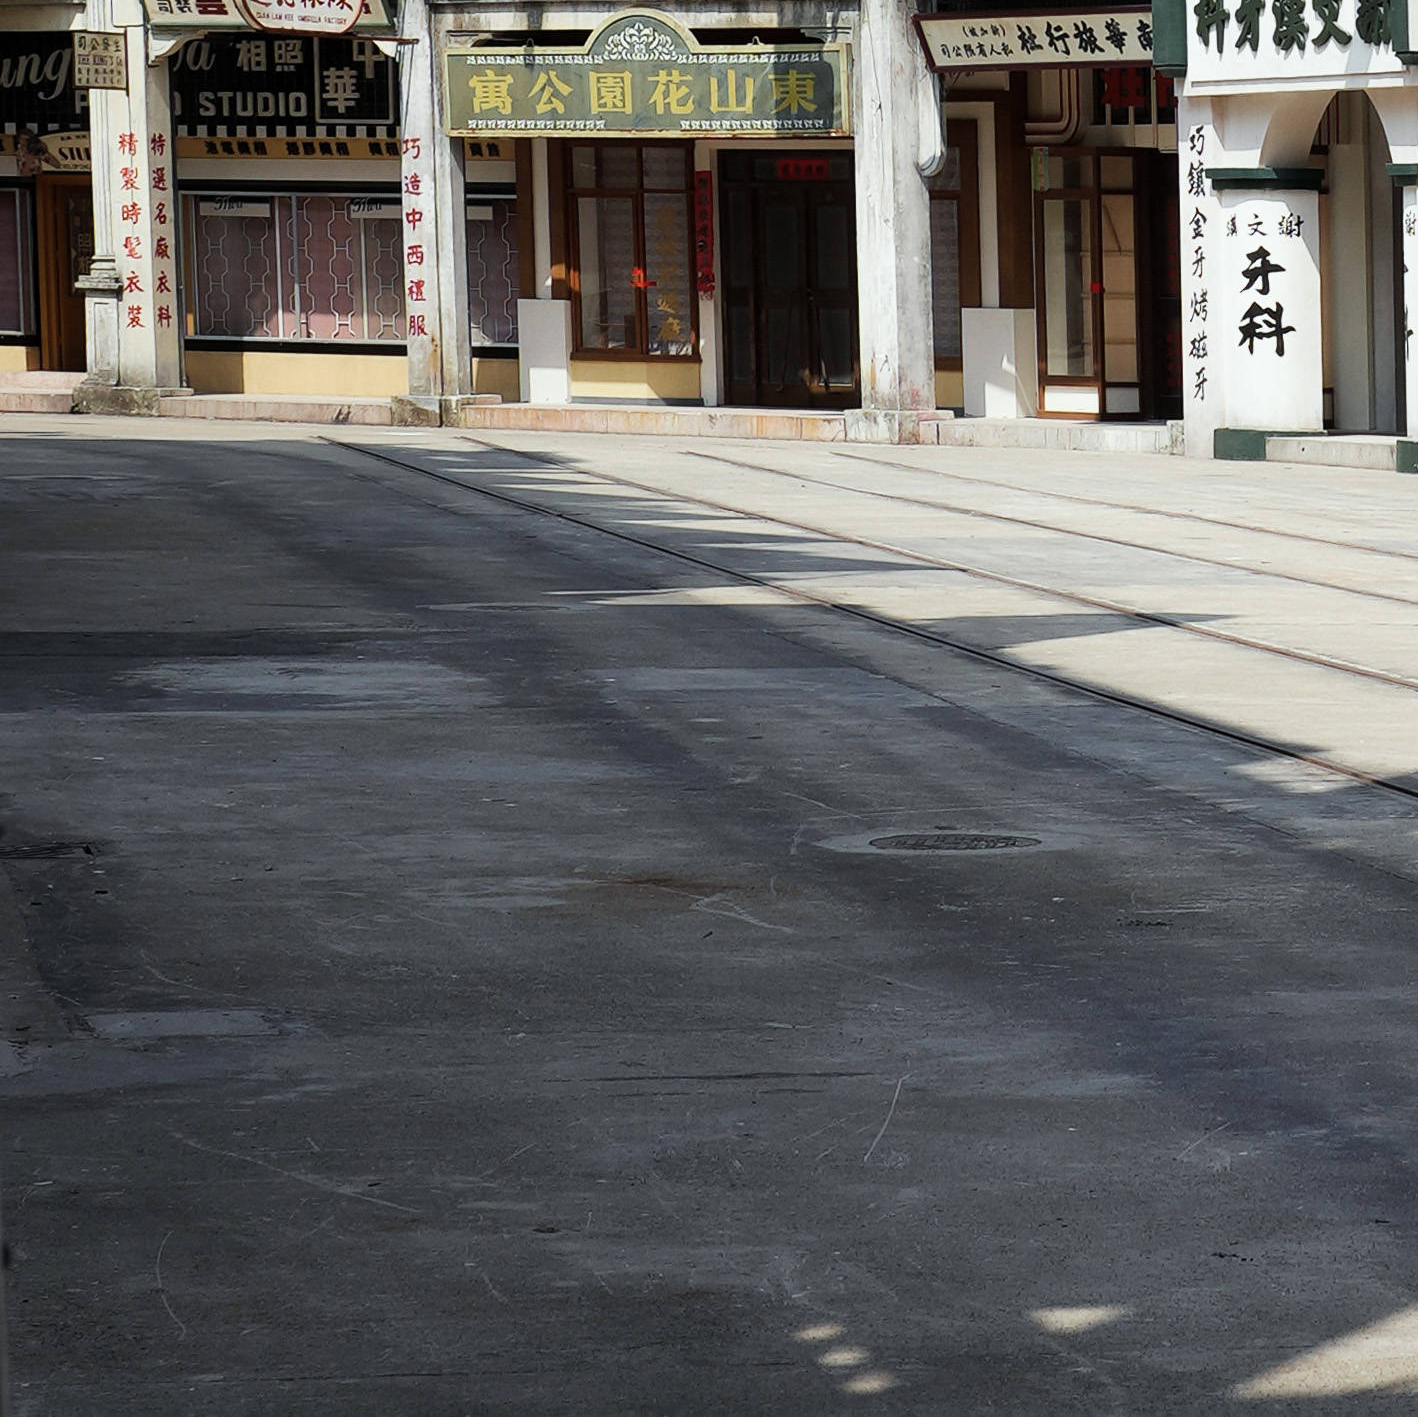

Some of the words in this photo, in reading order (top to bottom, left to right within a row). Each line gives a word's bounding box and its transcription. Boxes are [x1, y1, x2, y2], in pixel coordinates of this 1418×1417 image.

[236, 40, 304, 72] 照相
[199, 91, 308, 118] STUDIO
[467, 69, 818, 117] 東山花園公寓
[1238, 246, 1297, 357] 牙科
